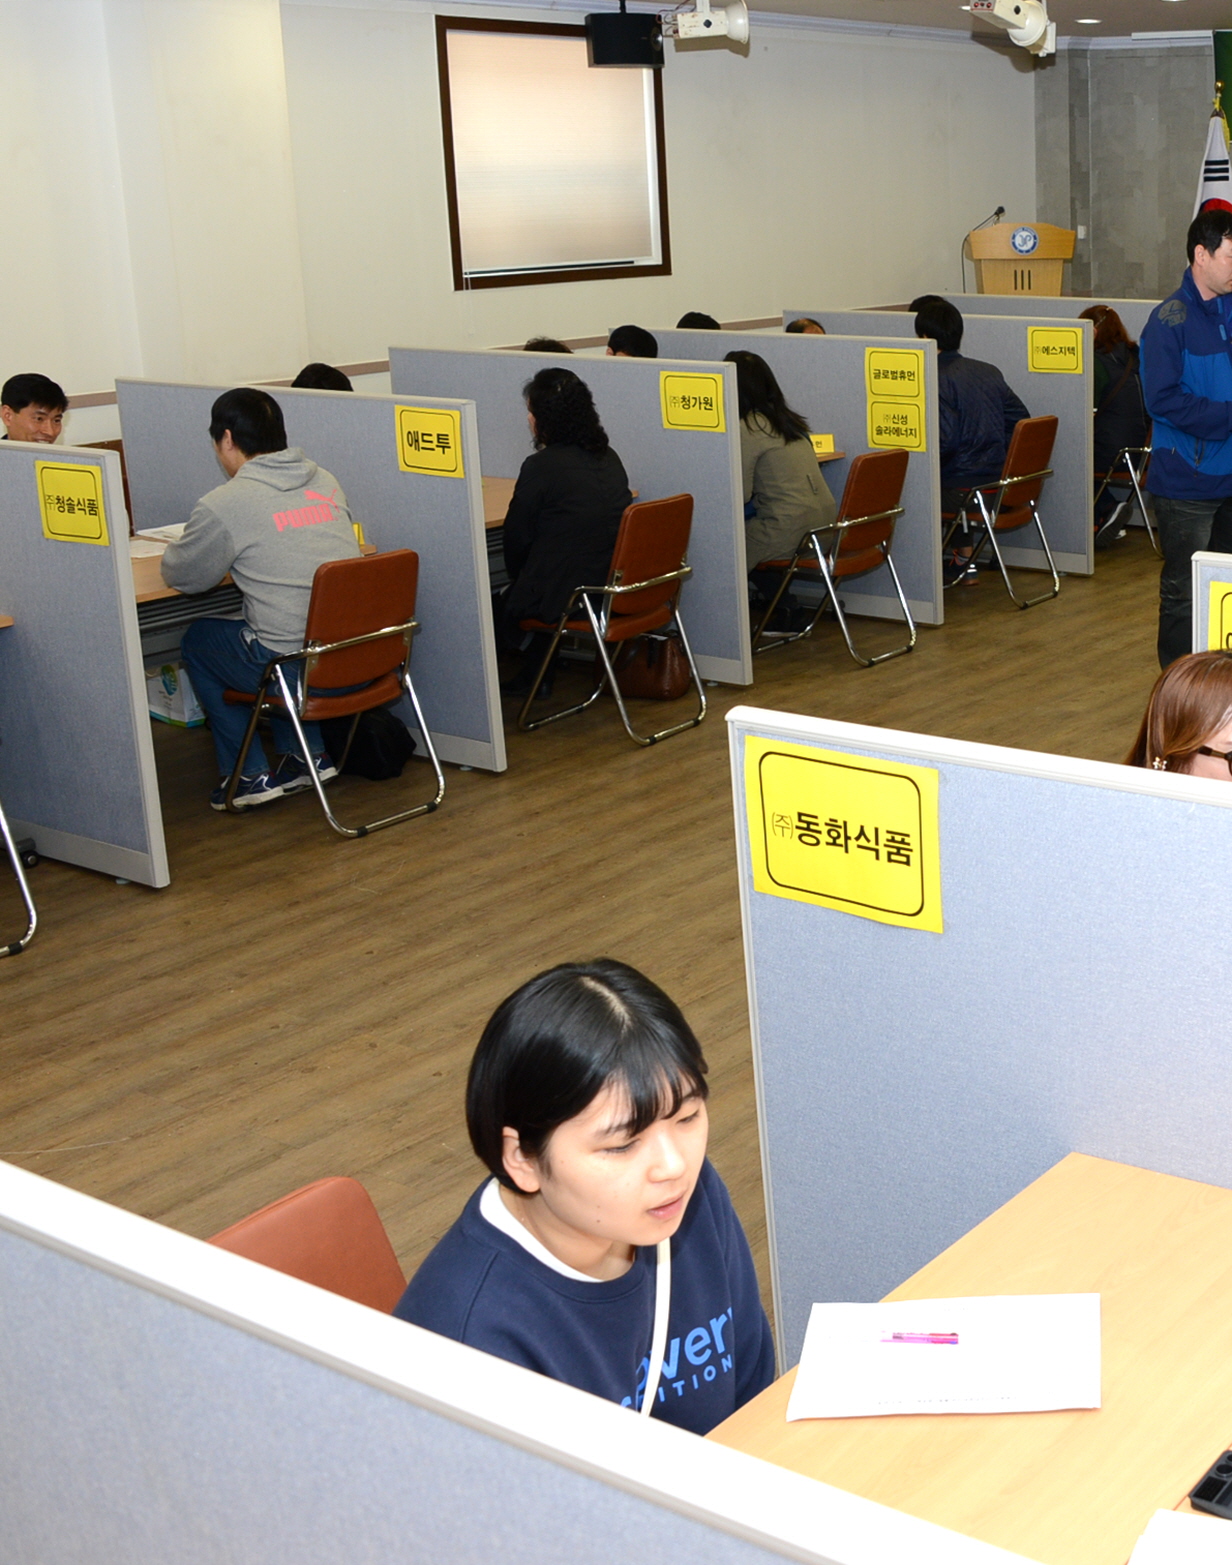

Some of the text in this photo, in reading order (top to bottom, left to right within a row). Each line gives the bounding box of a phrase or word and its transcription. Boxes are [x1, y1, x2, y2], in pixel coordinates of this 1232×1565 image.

[873, 367, 916, 383] 글로벌휴먼
[669, 394, 714, 411] (주)청가원
[406, 430, 452, 455] 애드투
[875, 425, 918, 441] 솔라에너지
[273, 504, 337, 533] PUMA
[771, 811, 914, 867] (주)동화식품
